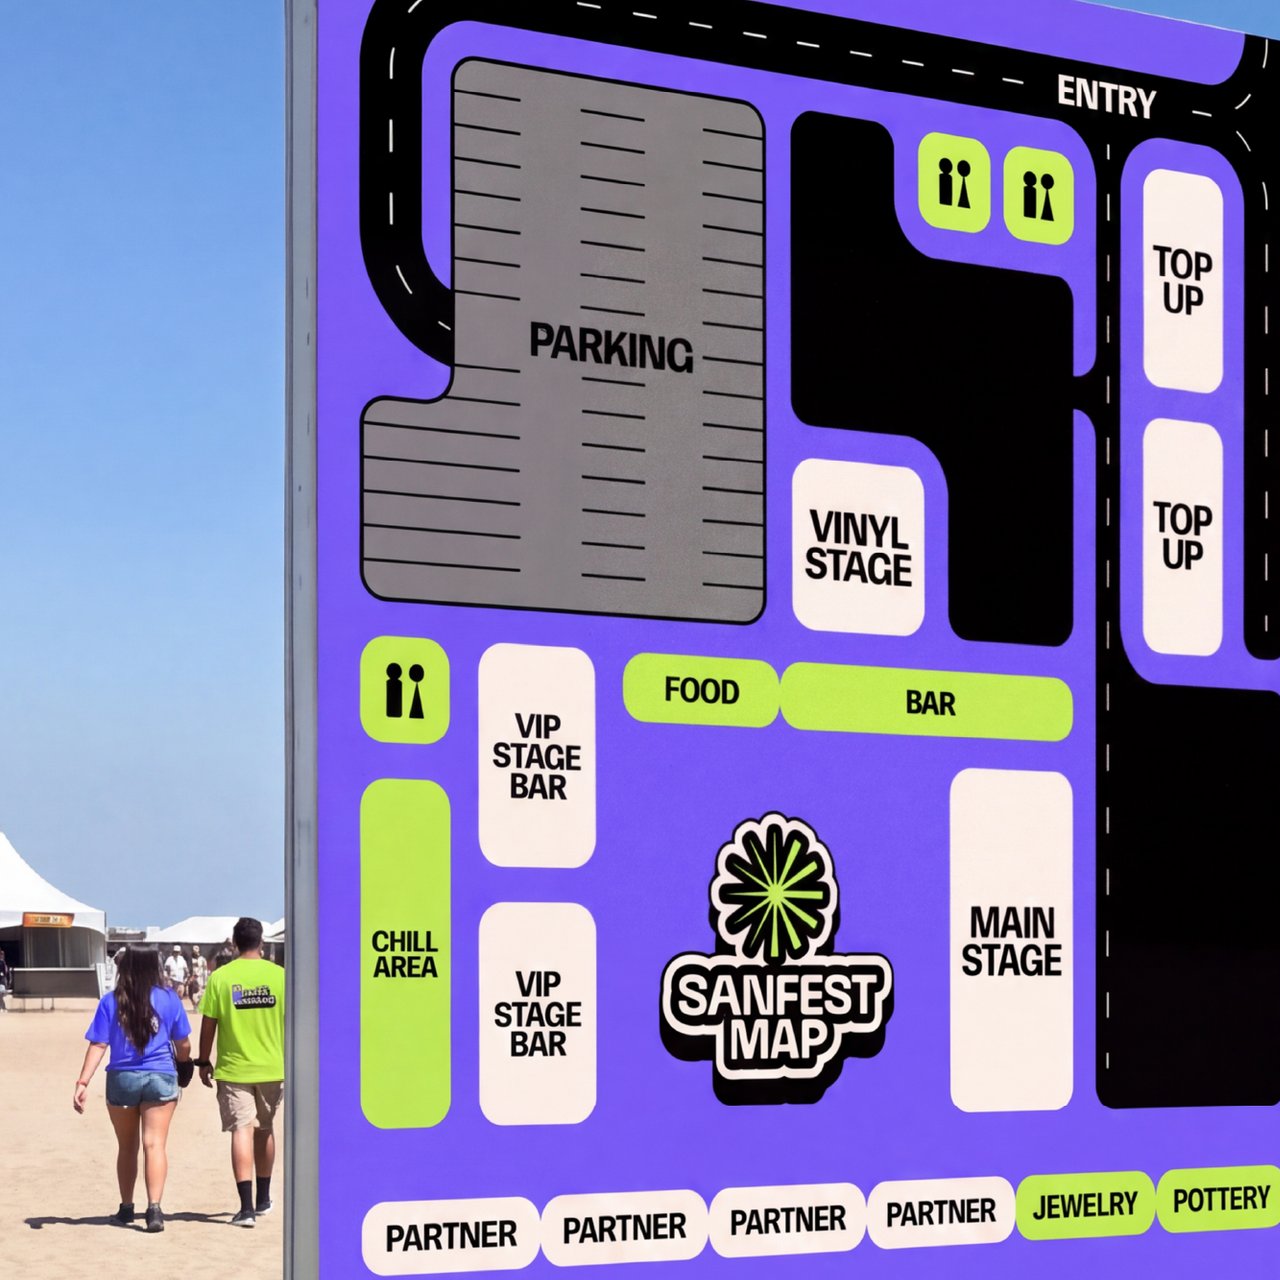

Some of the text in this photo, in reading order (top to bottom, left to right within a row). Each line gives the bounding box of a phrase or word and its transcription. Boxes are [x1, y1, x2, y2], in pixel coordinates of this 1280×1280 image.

[1058, 74, 1157, 119] ENTRY
[1153, 245, 1213, 281] TOP
[1163, 281, 1204, 316] UP
[529, 320, 694, 375] PARKING
[806, 509, 910, 551] VINYL
[1153, 501, 1213, 537] TOP
[804, 546, 913, 588] STAGE
[1163, 537, 1204, 571] UP
[665, 676, 740, 705] FOOD
[905, 689, 957, 717] BAR
[515, 713, 561, 739] VIP
[493, 742, 581, 771] STAGE
[510, 772, 567, 800] BAR
[970, 906, 1056, 939] MAIN
[371, 930, 439, 954] CHILL
[372, 954, 439, 979] AREA
[962, 942, 1062, 977] STAGE
[515, 971, 561, 997] VIP
[678, 973, 878, 1016] SANFEST
[494, 1000, 582, 1029] STAGE
[510, 1030, 567, 1057] BAR
[730, 1018, 828, 1060] MAP
[886, 1197, 997, 1228] PARTNER
[1033, 1191, 1138, 1220] JEWELRY
[1173, 1184, 1271, 1213] POTTERY
[386, 1219, 517, 1252] PARTNER
[563, 1212, 687, 1244] PARTNER
[730, 1205, 847, 1236] PARTNER
